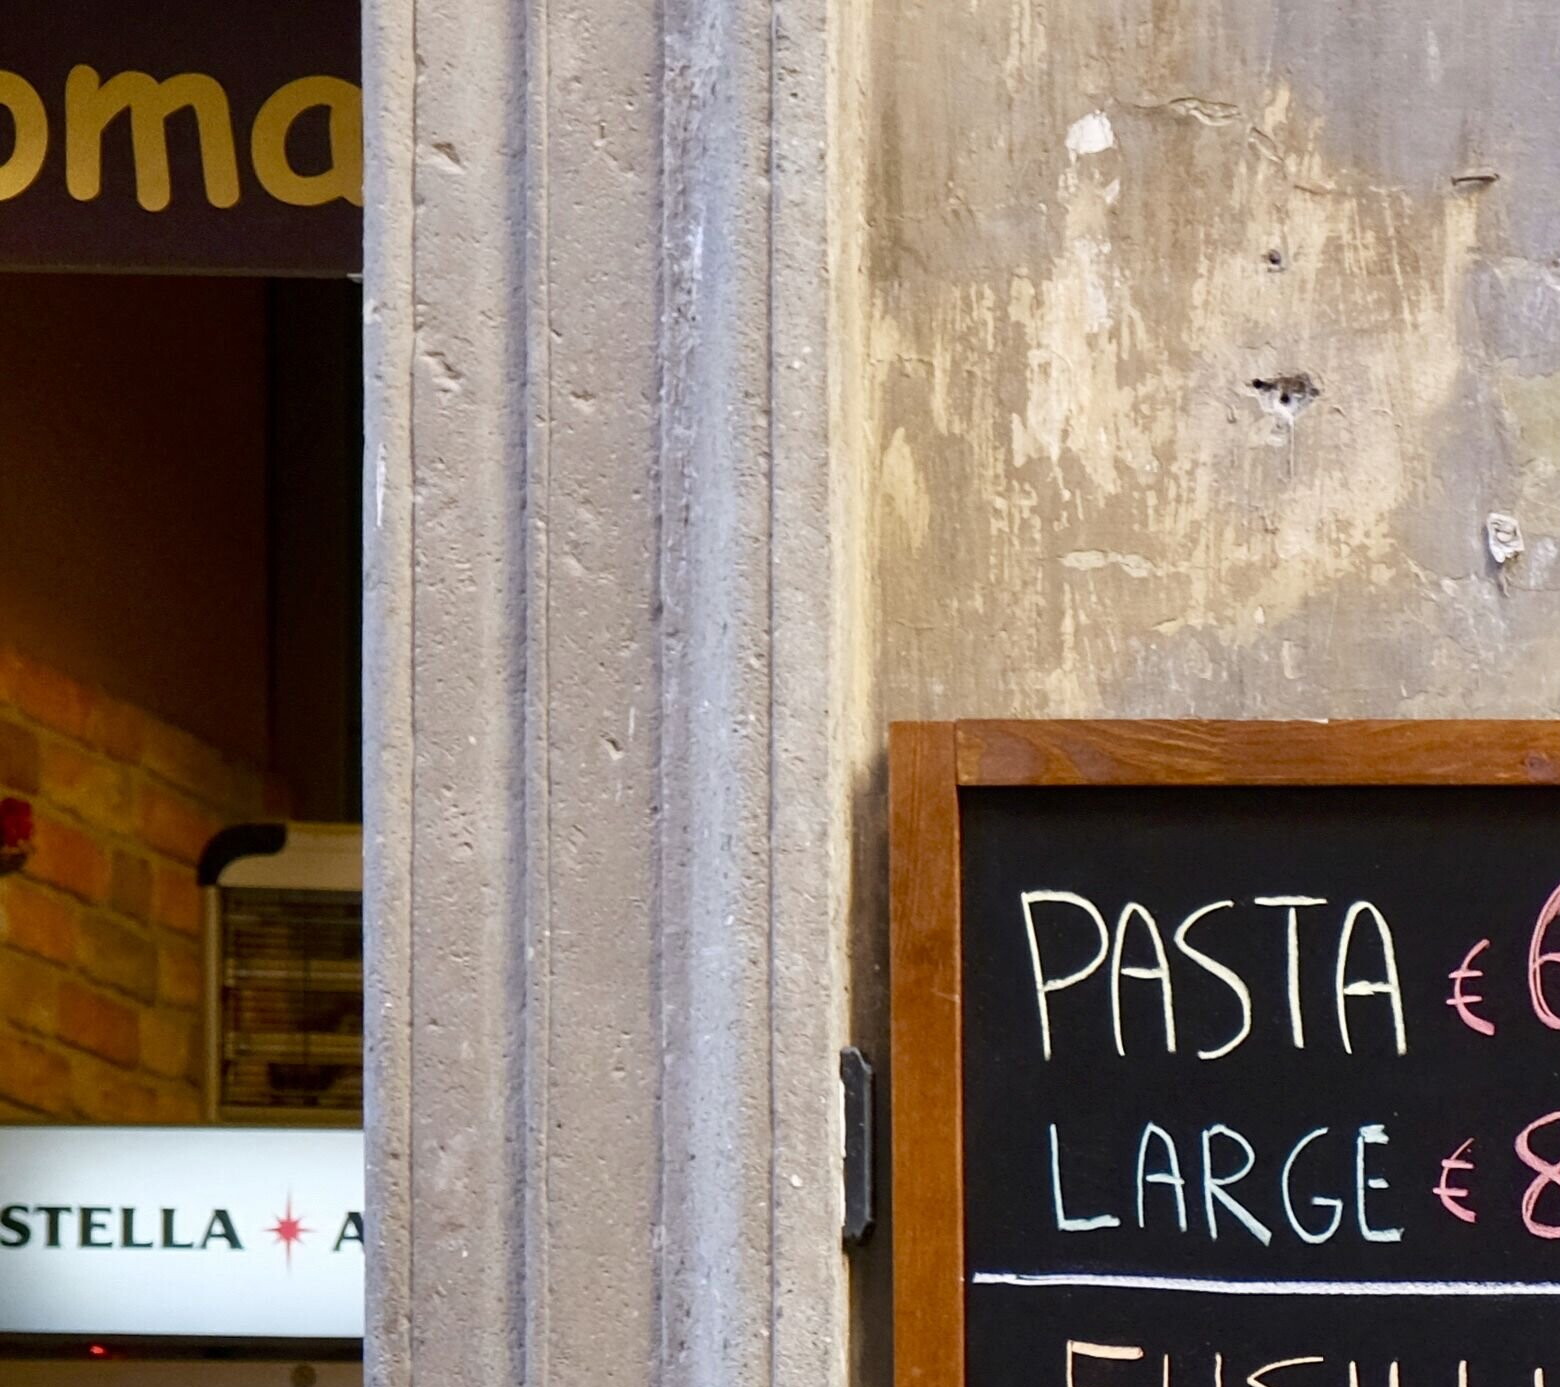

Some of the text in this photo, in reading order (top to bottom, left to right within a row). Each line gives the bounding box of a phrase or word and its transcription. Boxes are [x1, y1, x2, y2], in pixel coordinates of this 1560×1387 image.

[1021, 890, 1406, 1060] PASTA
[1446, 939, 1494, 1035] €
[0, 1205, 244, 1249] STELLA
[1050, 1122, 1403, 1245] LARGE
[1433, 1139, 1476, 1222] €
